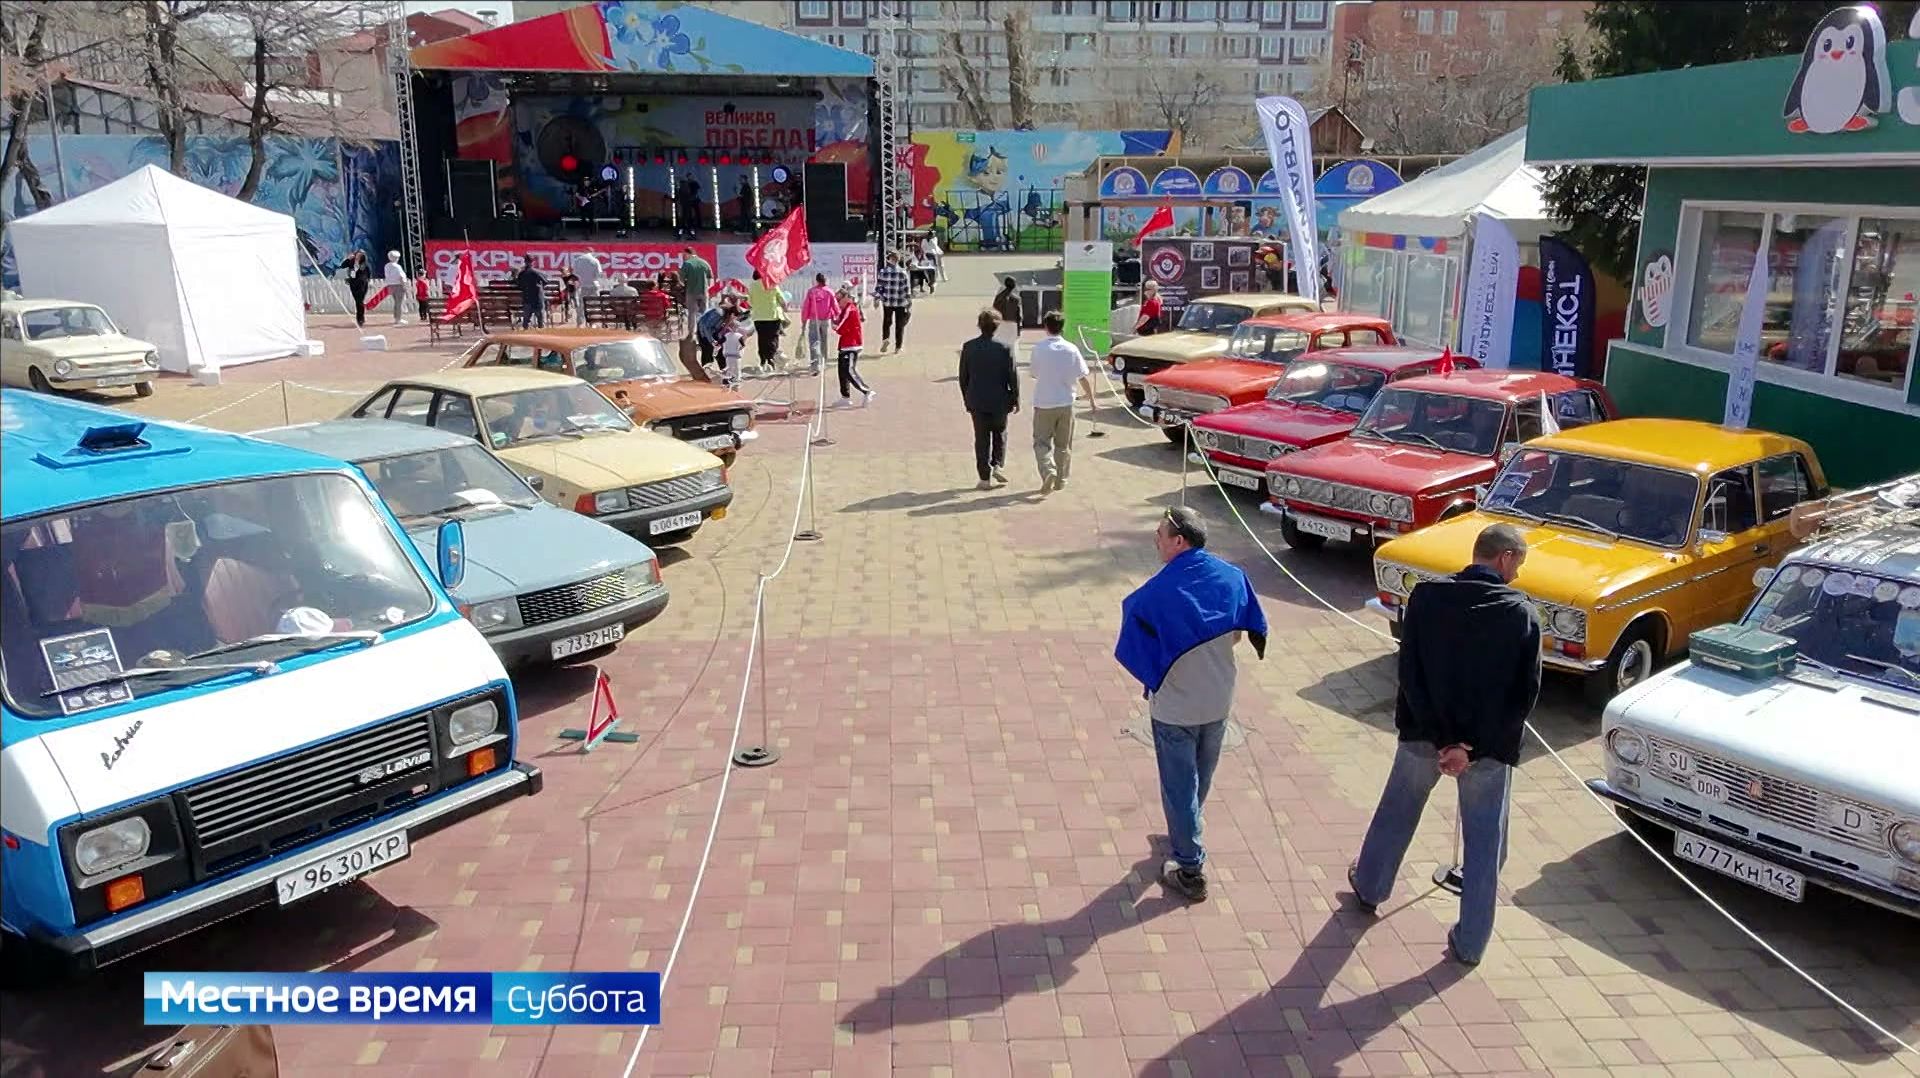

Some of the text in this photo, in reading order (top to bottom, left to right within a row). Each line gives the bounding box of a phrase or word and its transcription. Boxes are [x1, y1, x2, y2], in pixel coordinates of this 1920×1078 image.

[704, 110, 776, 125] ВЕЛИКАЯ
[705, 127, 816, 152] ПОБЕДА!
[433, 250, 583, 269] ОКРЫТИ
[1669, 752, 1688, 771] SU
[1697, 780, 1721, 798] DDR
[1844, 808, 1861, 829] D
[369, 836, 400, 865] КР
